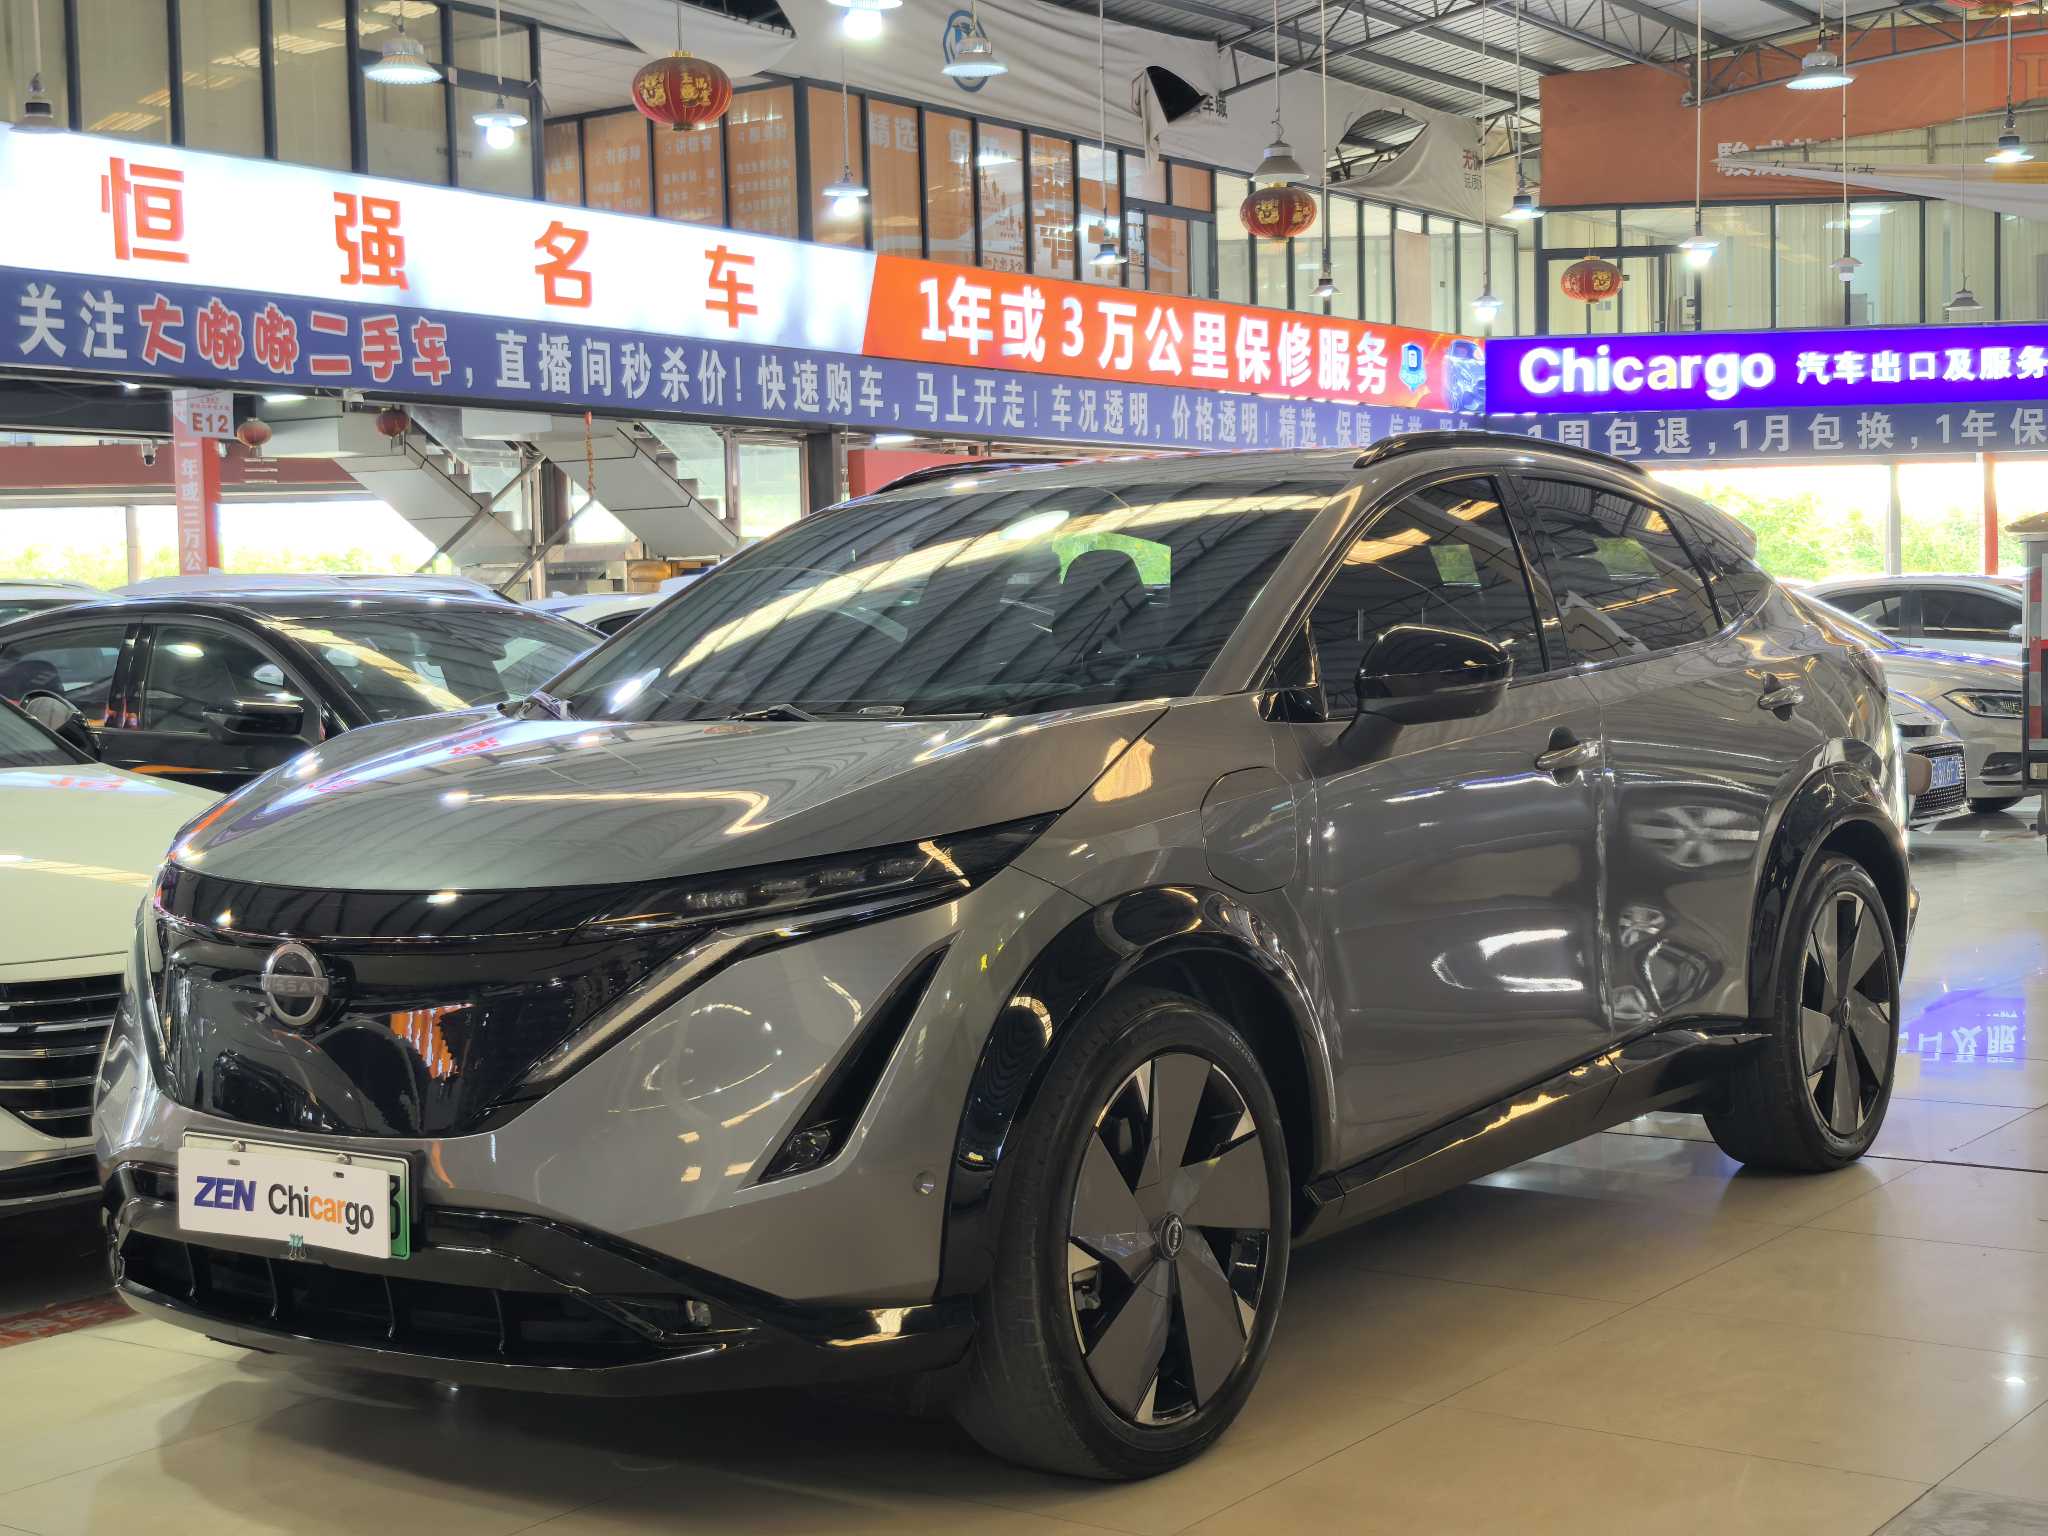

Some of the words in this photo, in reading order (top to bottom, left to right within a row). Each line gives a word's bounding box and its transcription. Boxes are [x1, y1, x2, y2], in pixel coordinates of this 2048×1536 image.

[101, 157, 759, 329] 恒强名车
[919, 276, 1388, 394] 1年或3万公里保修服务
[1519, 345, 1776, 400] Chicargo
[1797, 346, 2048, 384] 汽车出口及服务
[192, 413, 230, 433] E12
[194, 1175, 257, 1212] ZEN
[268, 1183, 375, 1234] Chicargo
